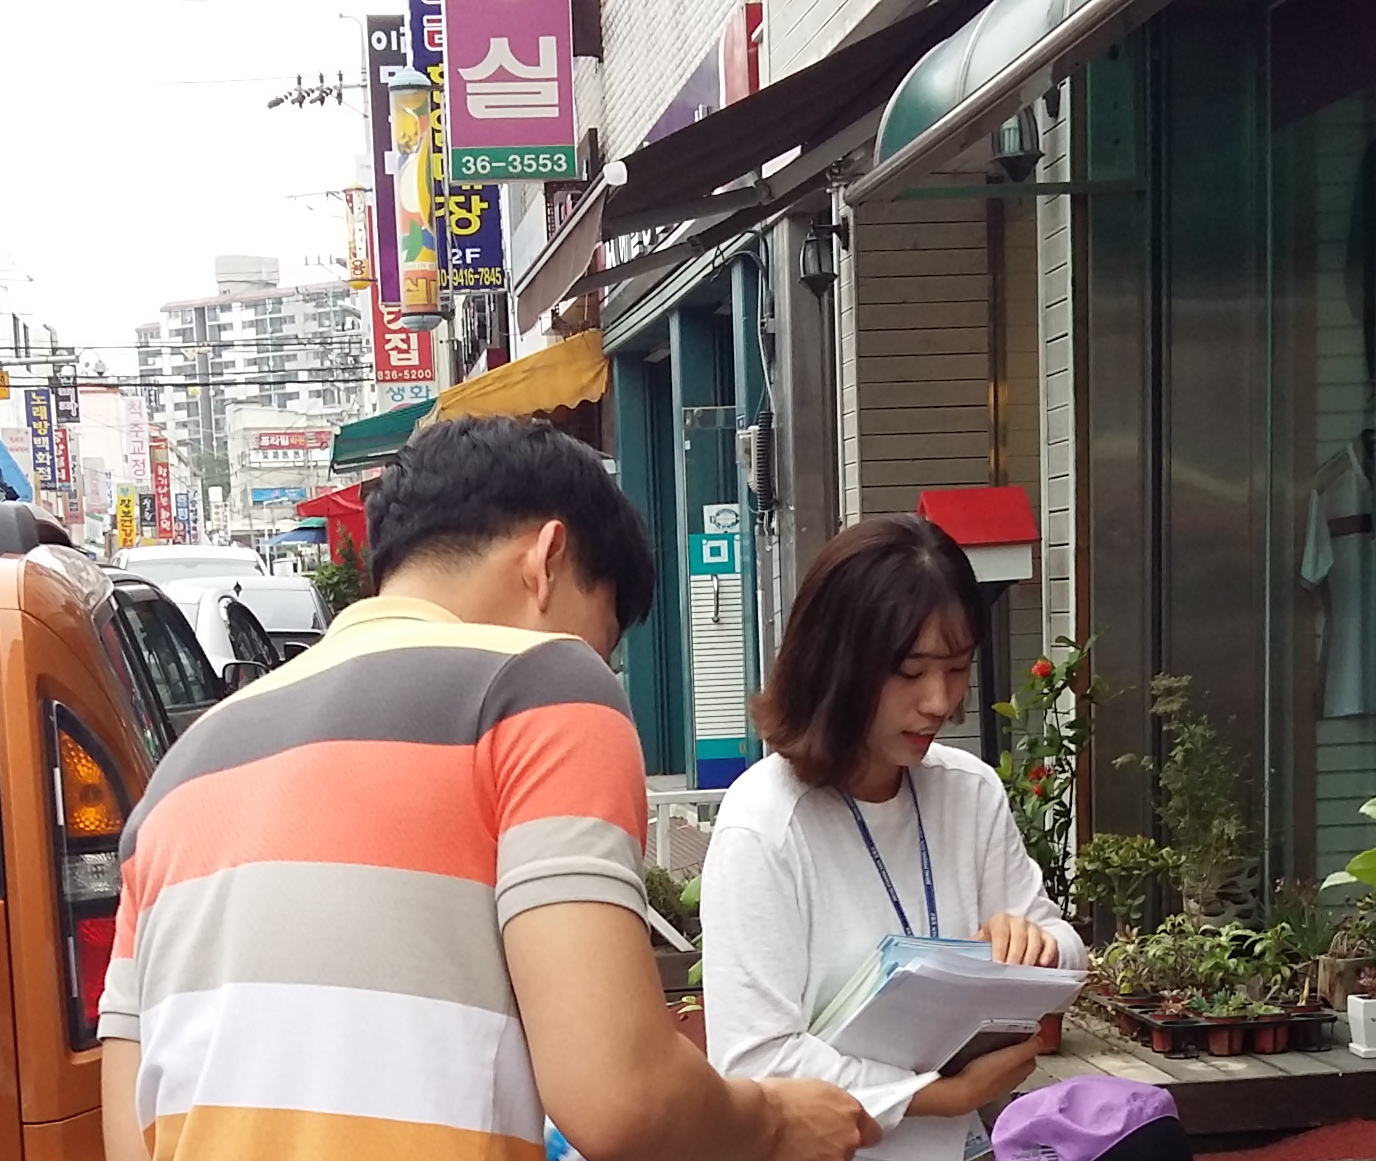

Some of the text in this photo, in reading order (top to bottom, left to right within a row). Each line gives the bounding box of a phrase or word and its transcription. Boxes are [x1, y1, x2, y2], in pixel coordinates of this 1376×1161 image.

[458, 36, 560, 119] 실
[377, 369, 432, 381] 836-5200
[386, 384, 433, 402] 생화
